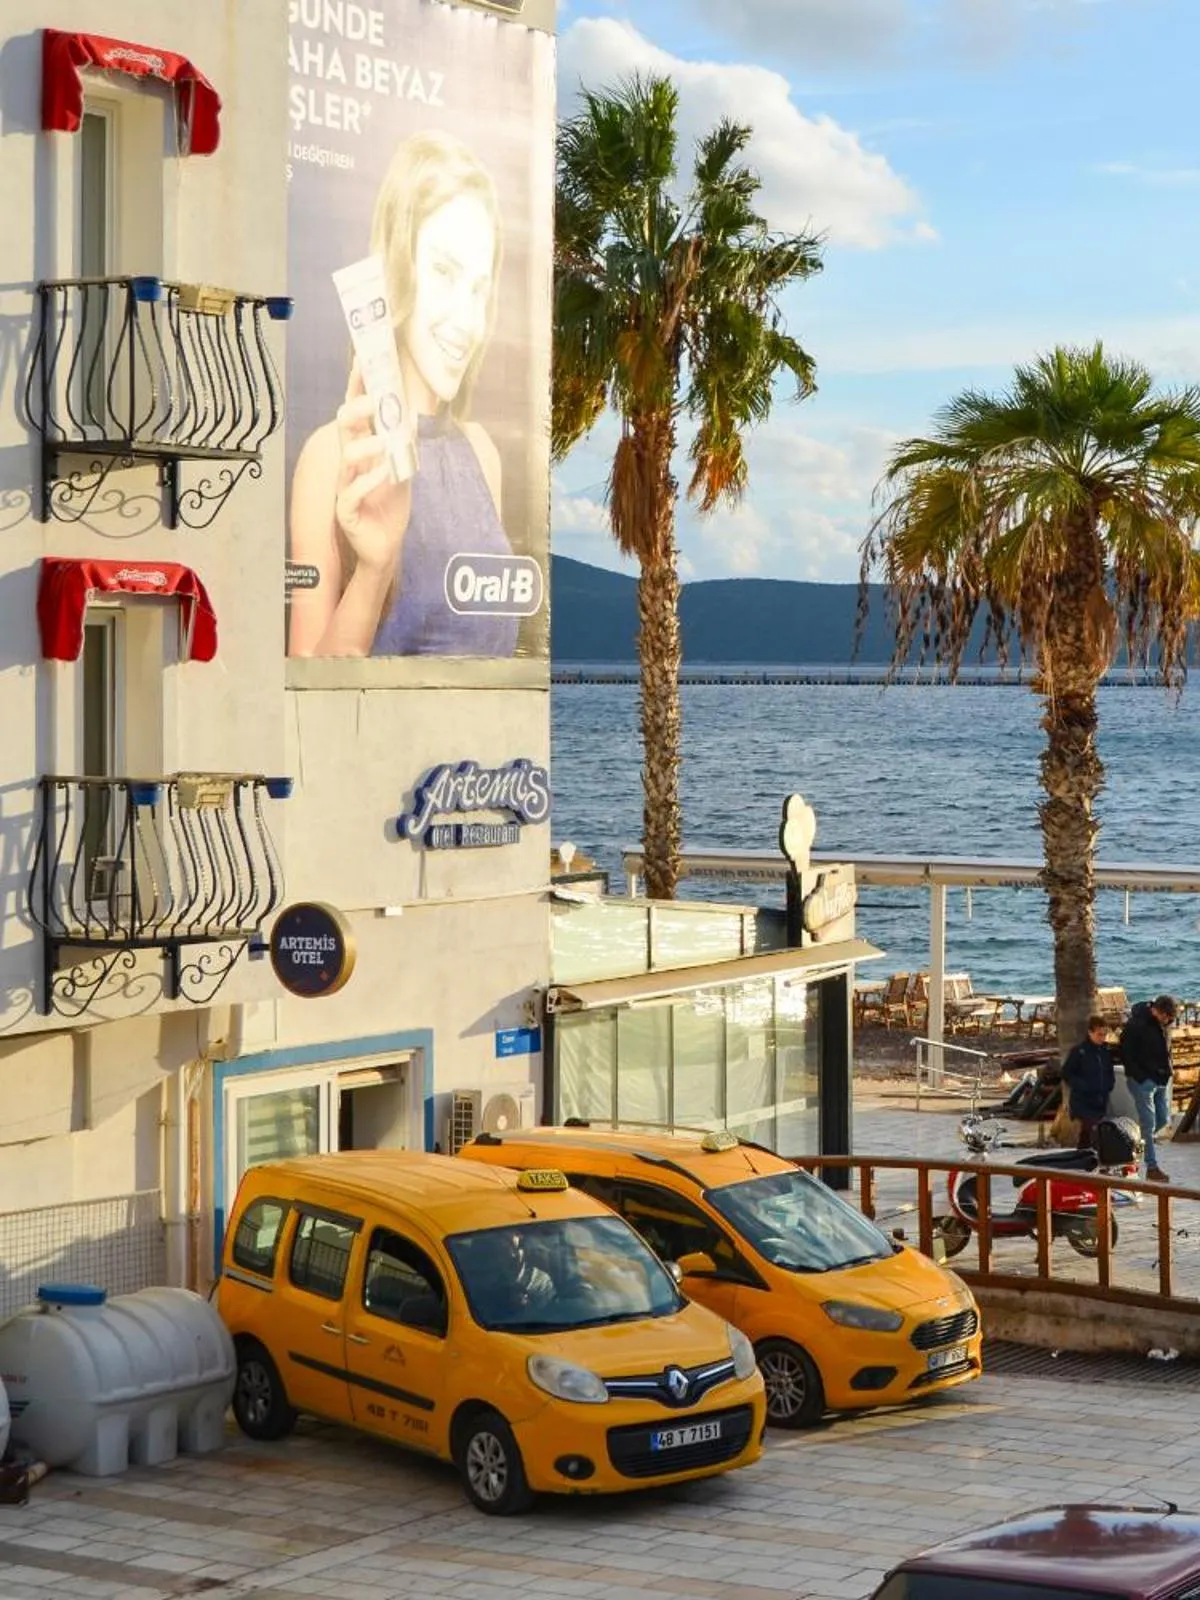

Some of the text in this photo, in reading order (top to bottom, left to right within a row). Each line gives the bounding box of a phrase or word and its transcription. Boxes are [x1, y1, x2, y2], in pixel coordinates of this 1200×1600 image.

[355, 53, 445, 107] BEYAZ
[454, 565, 534, 603] Oral-B
[408, 762, 549, 835] Artemis
[292, 951, 324, 964] OTEL
[658, 1423, 719, 1448] 48 T 7151
